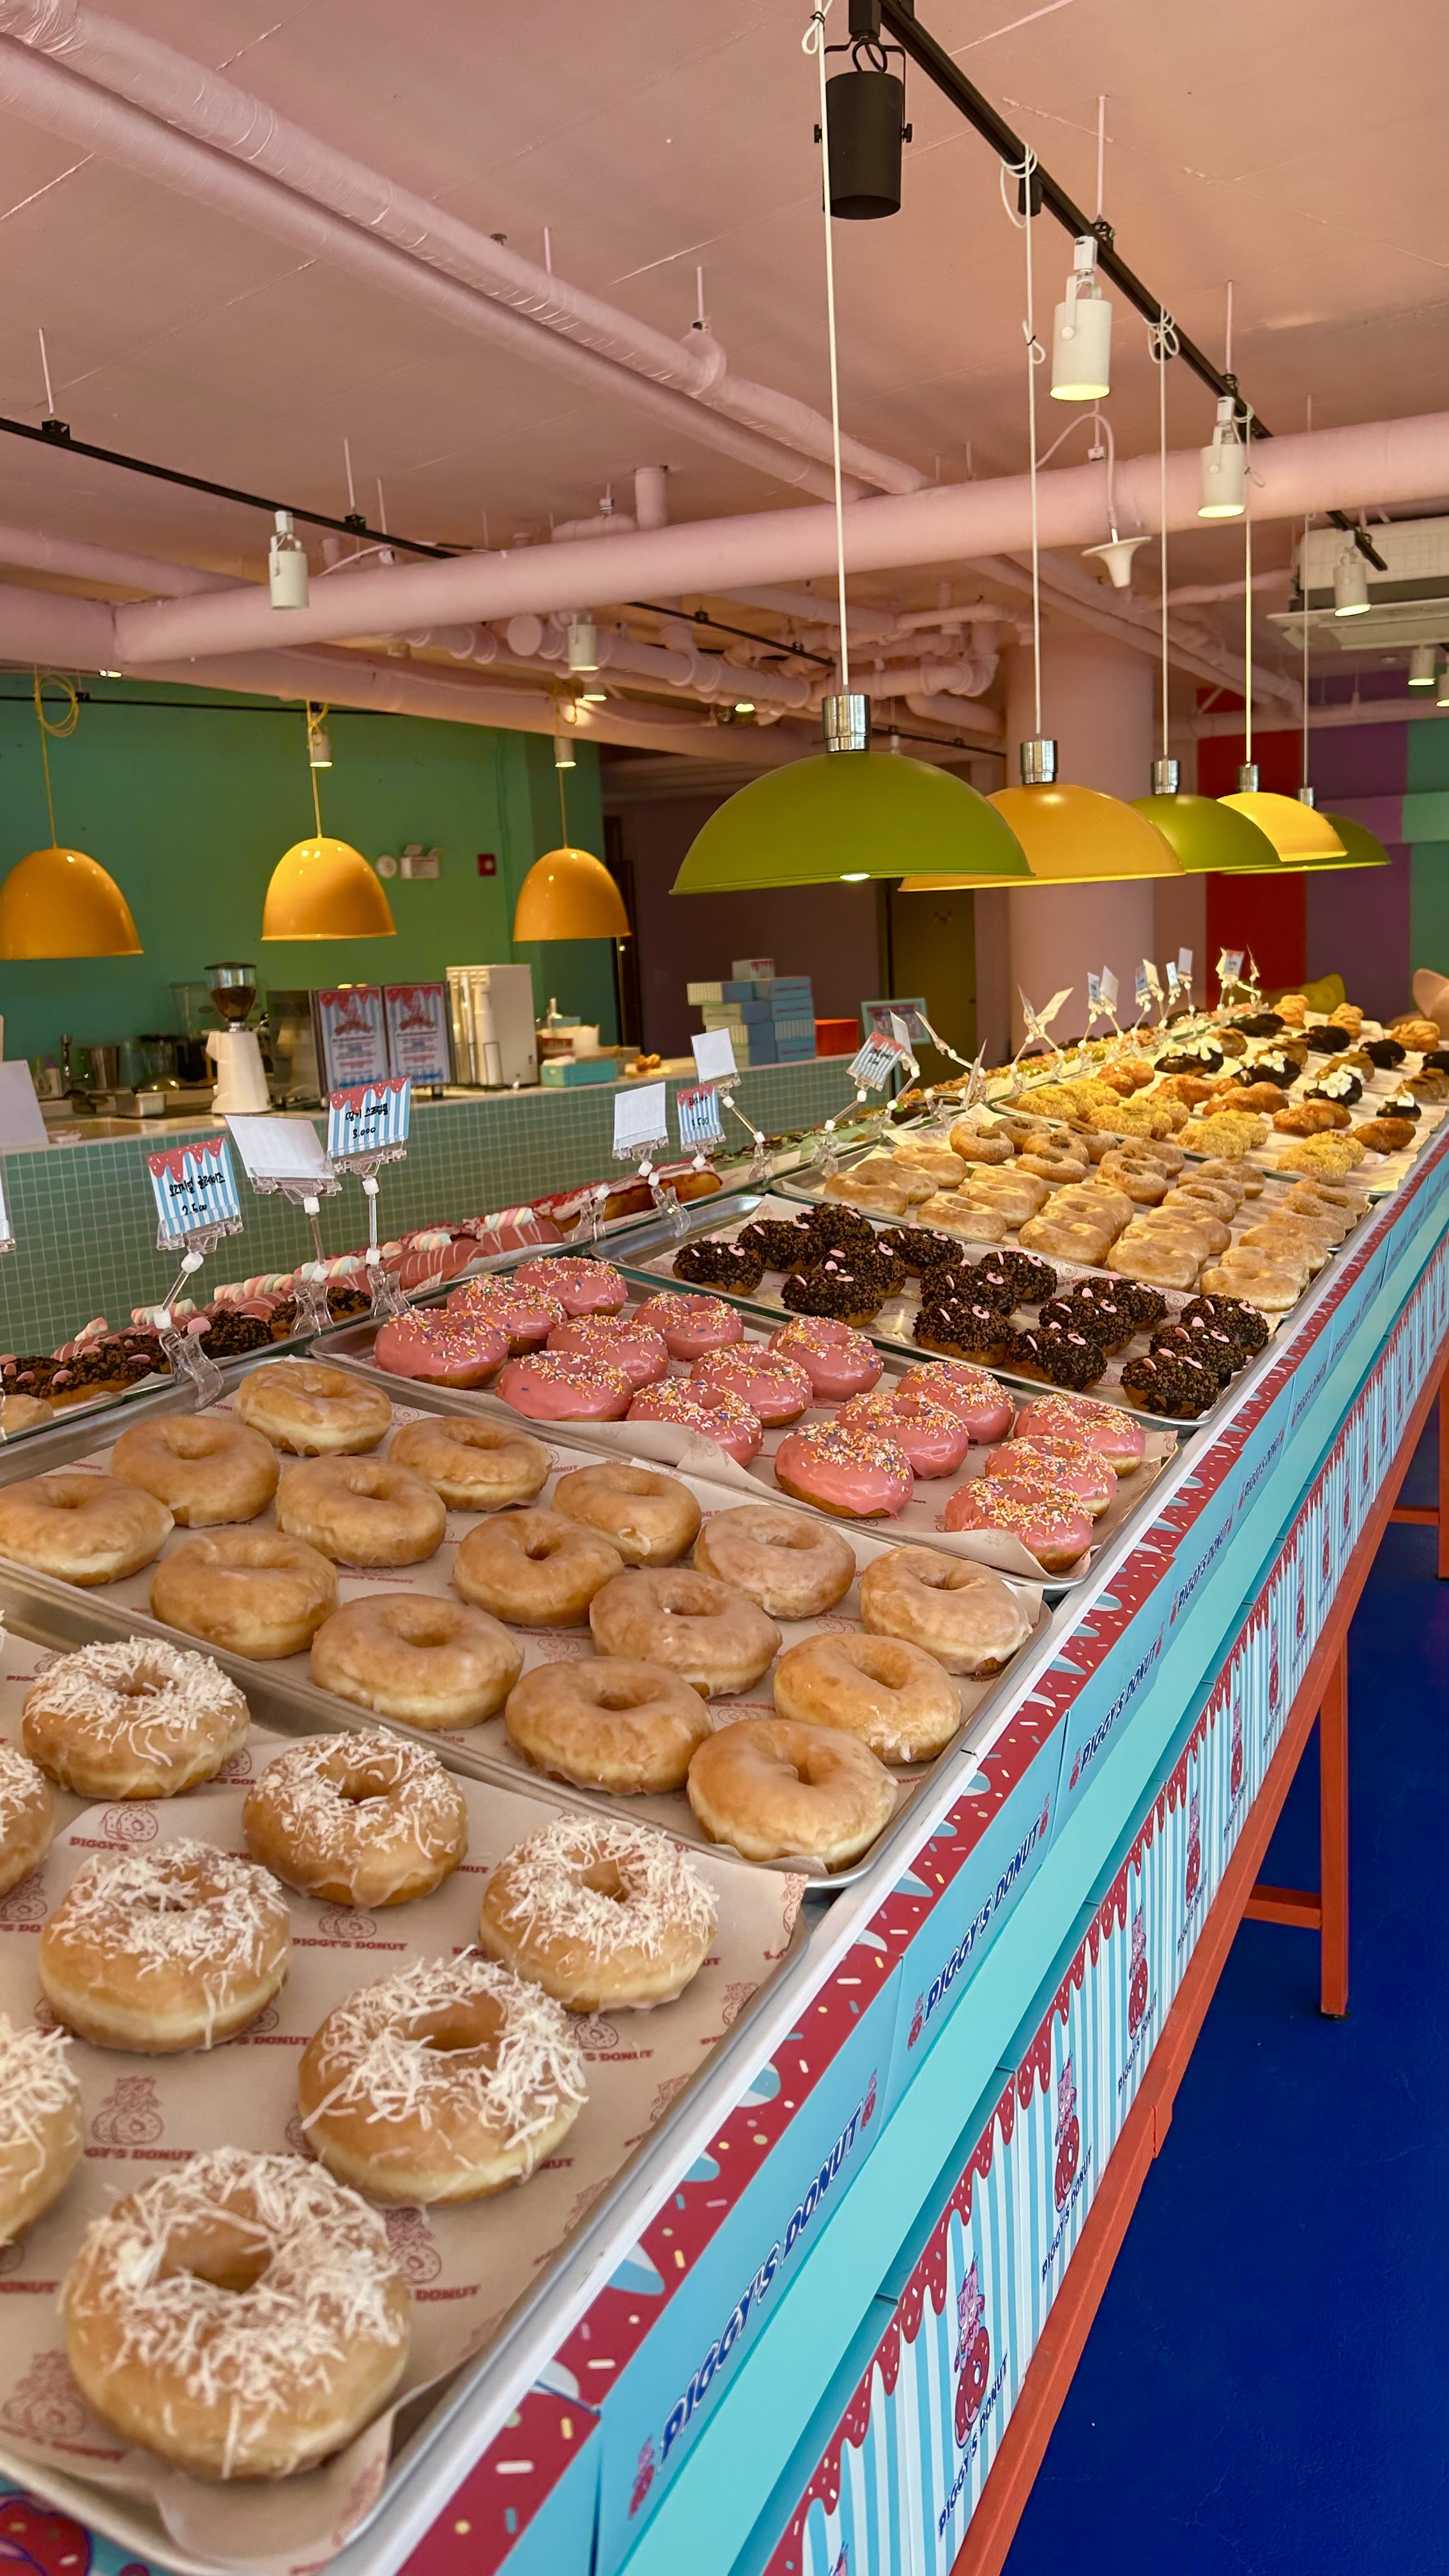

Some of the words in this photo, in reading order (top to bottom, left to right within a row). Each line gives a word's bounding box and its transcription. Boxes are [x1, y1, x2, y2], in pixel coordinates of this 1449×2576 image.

[1079, 1688, 1126, 1779] PIGGY'S
[1124, 1636, 1159, 1706] DONUT
[70, 1836, 129, 1851] PIGGY'S
[292, 1937, 352, 1948] PIGGY'S
[356, 1940, 408, 1951] DONUT
[923, 1892, 993, 2028] PIGGY'S
[992, 1812, 1041, 1919] DONUT
[657, 2240, 781, 2472] PIGGY'S
[781, 2099, 864, 2269] DONUT
[1041, 2201, 1071, 2287] PIGGY'S
[1070, 2143, 1092, 2212] DONUT
[415, 2284, 481, 2301] DONUT
[938, 2429, 979, 2542] PIGGY'S
[979, 2349, 1008, 2440] DONUT
